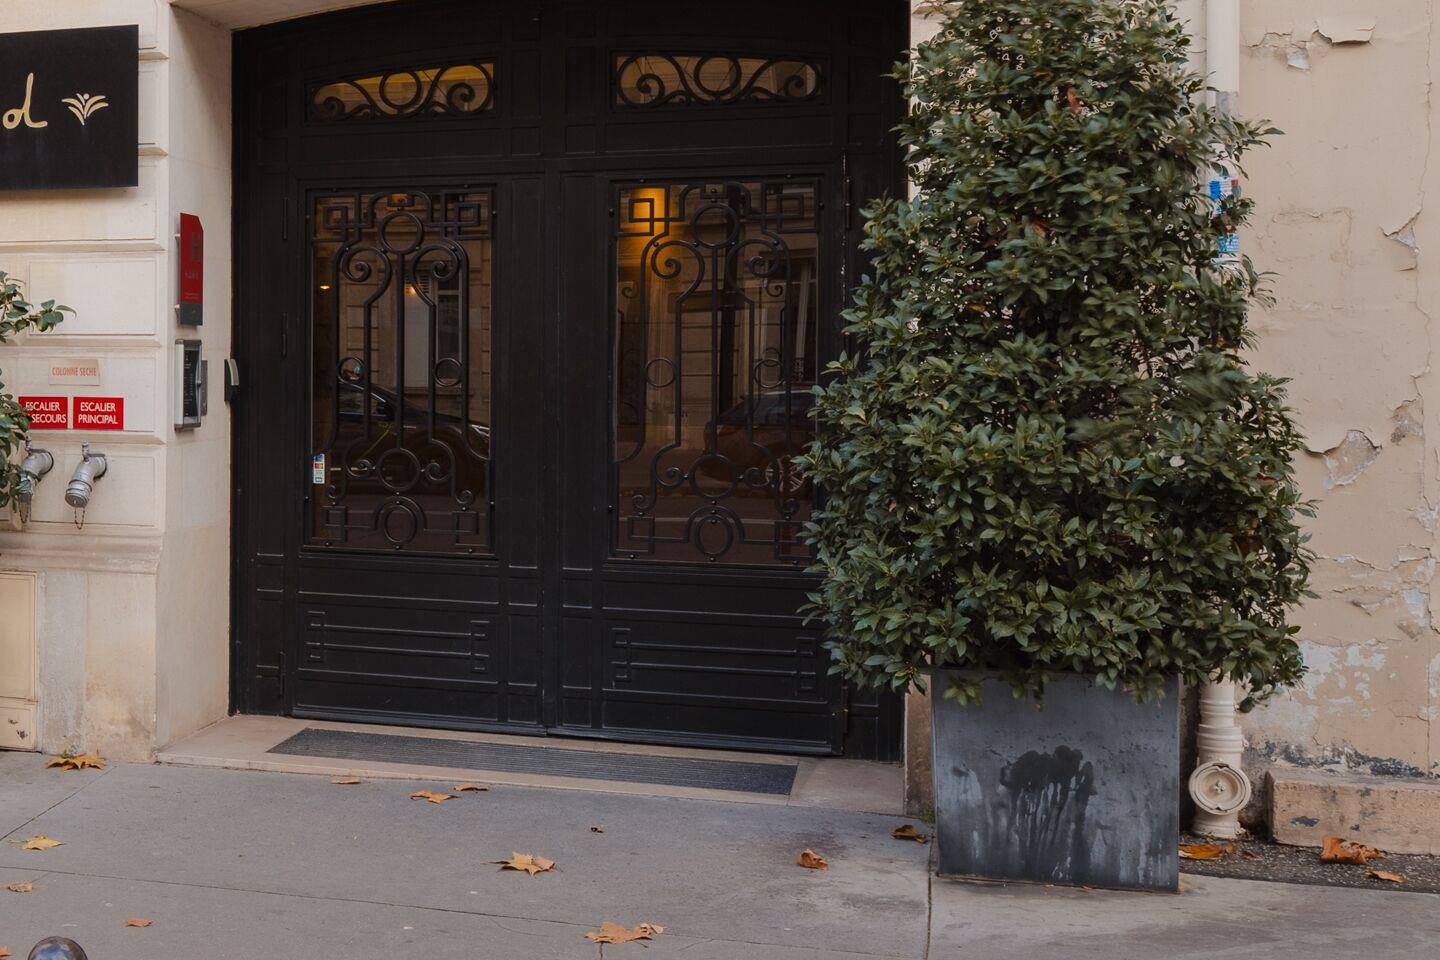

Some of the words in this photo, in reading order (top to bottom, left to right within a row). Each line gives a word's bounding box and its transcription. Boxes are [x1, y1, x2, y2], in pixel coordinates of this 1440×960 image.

[80, 402, 116, 412] ESCALIER
[32, 413, 66, 423] SECOURS
[78, 414, 118, 425] PRINCIPAL
